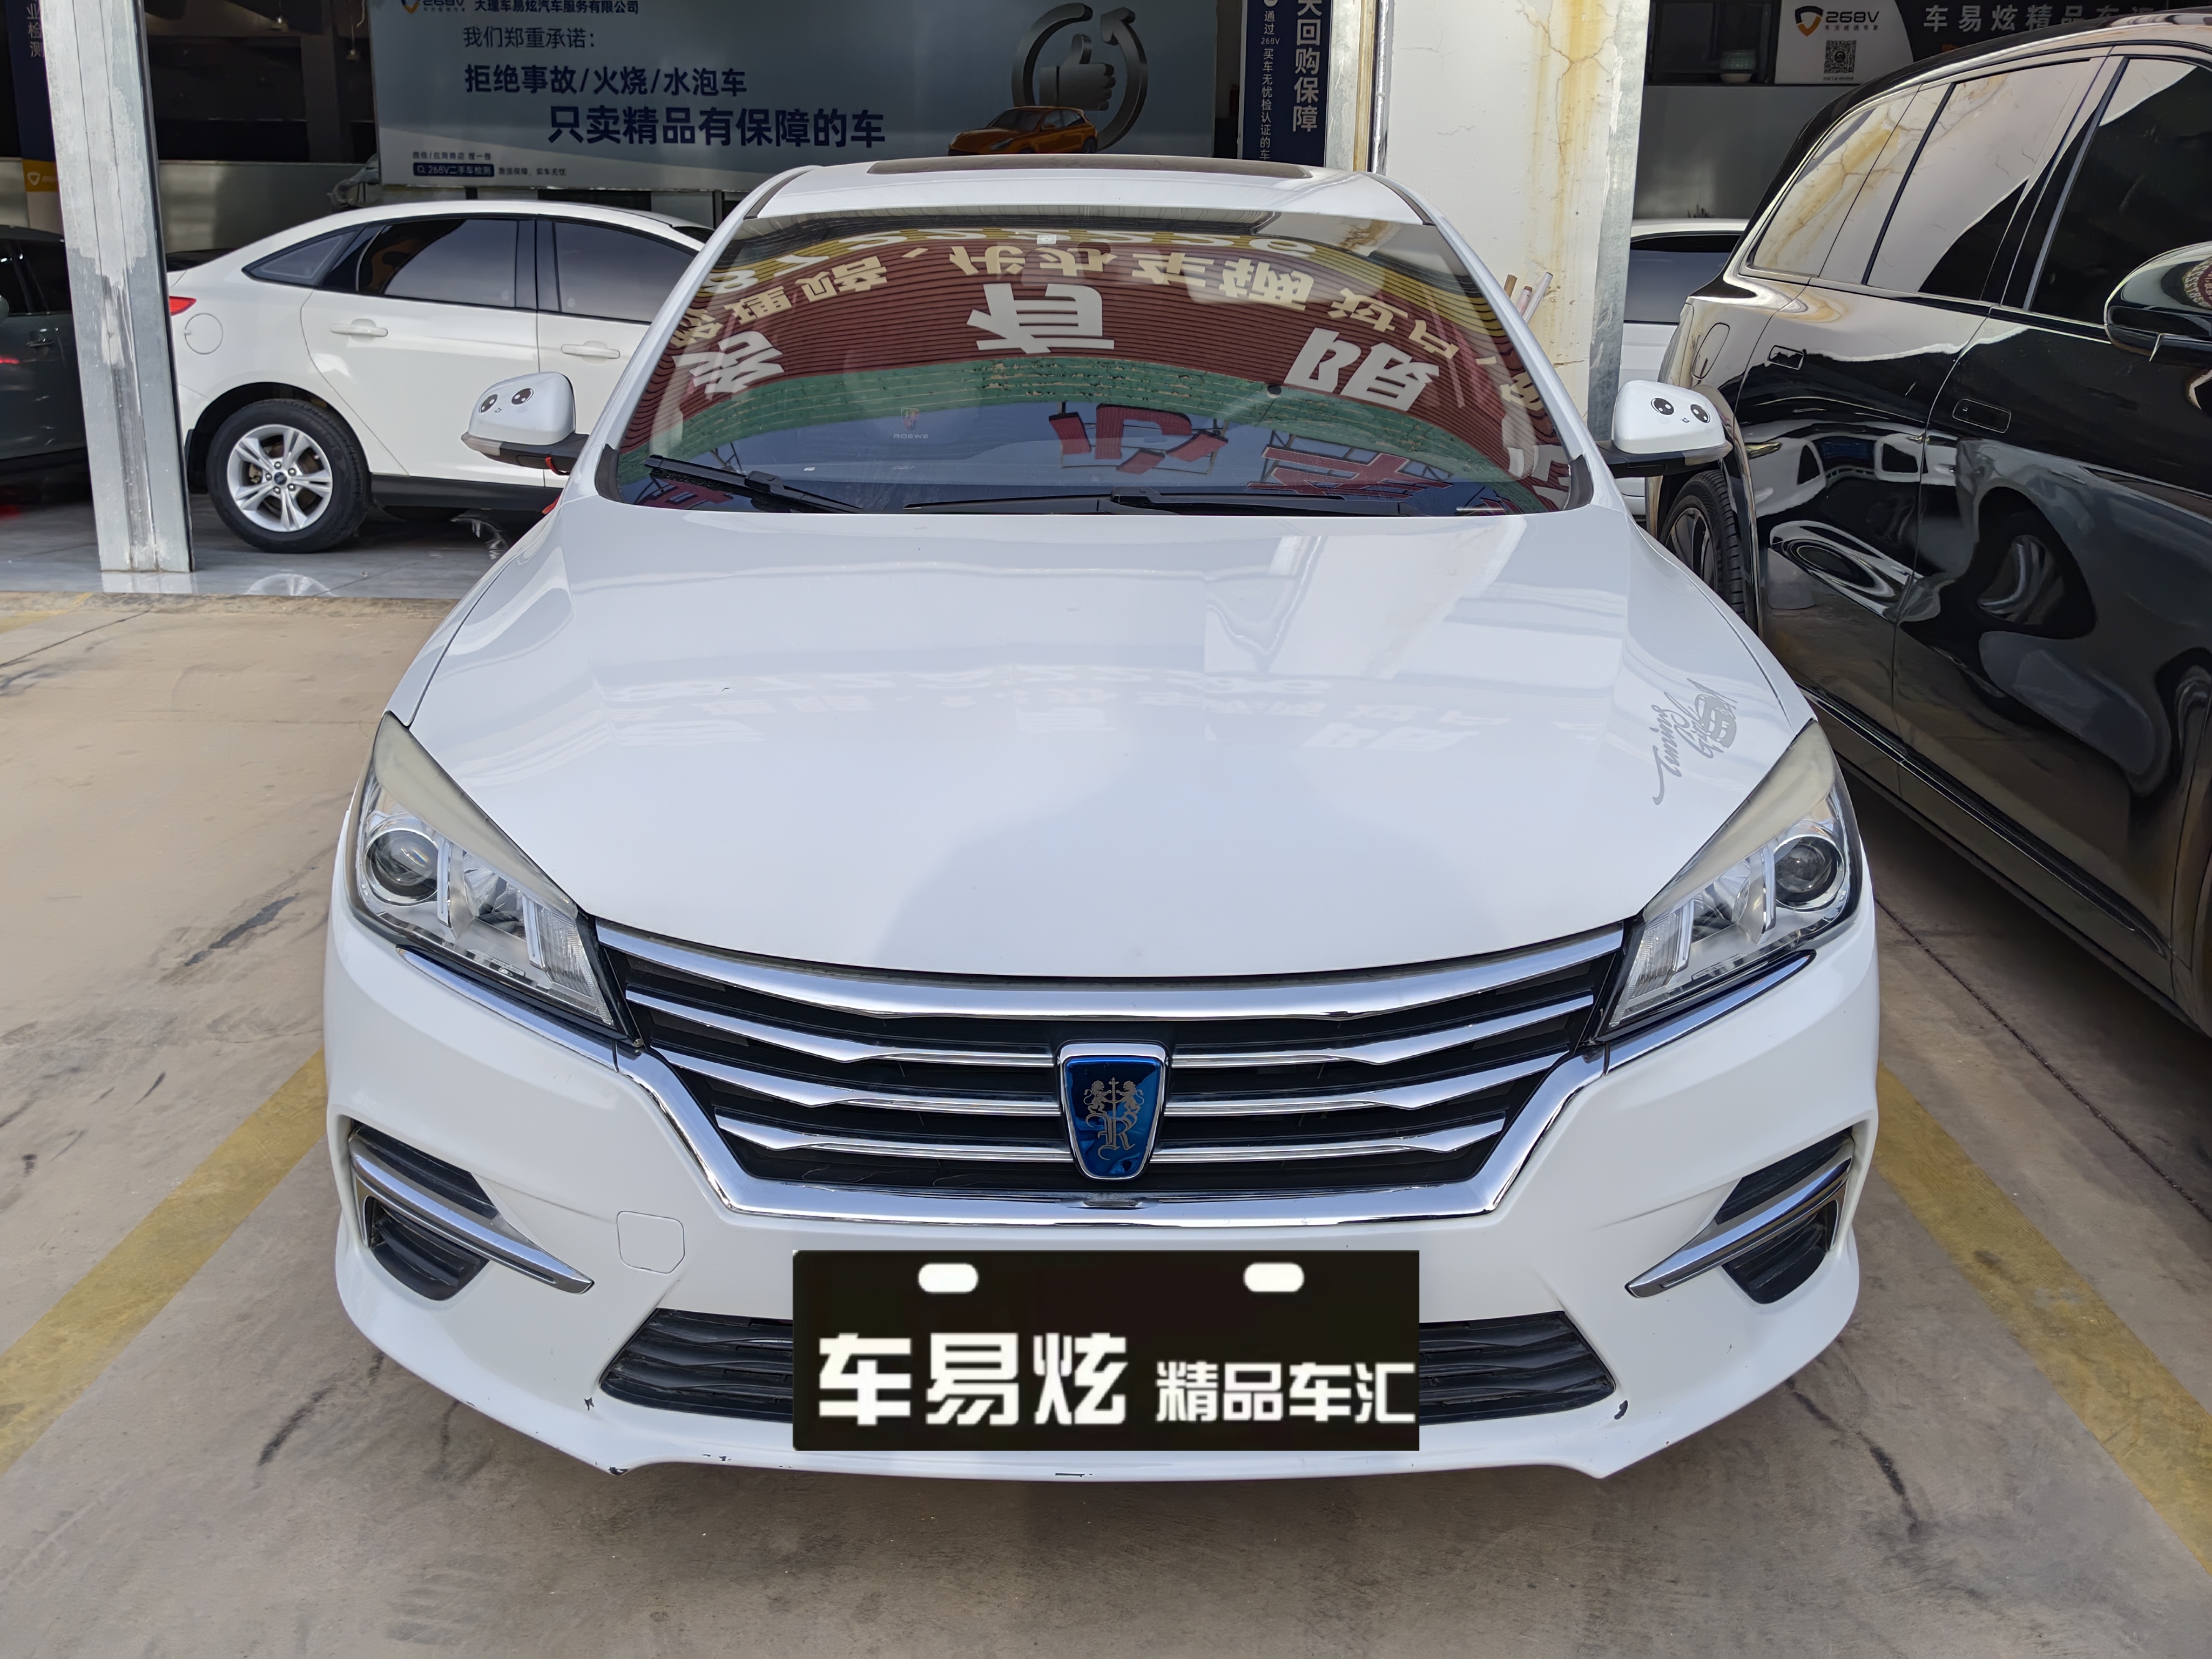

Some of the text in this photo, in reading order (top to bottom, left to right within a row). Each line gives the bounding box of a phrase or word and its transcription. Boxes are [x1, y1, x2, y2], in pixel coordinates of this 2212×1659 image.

[1826, 11, 1880, 23] 268V
[1924, 5, 2154, 32] 车易炫精品
[464, 64, 747, 97] 拒绝事故/火烧/水泡车
[548, 105, 886, 149] 只卖精品有保障的车
